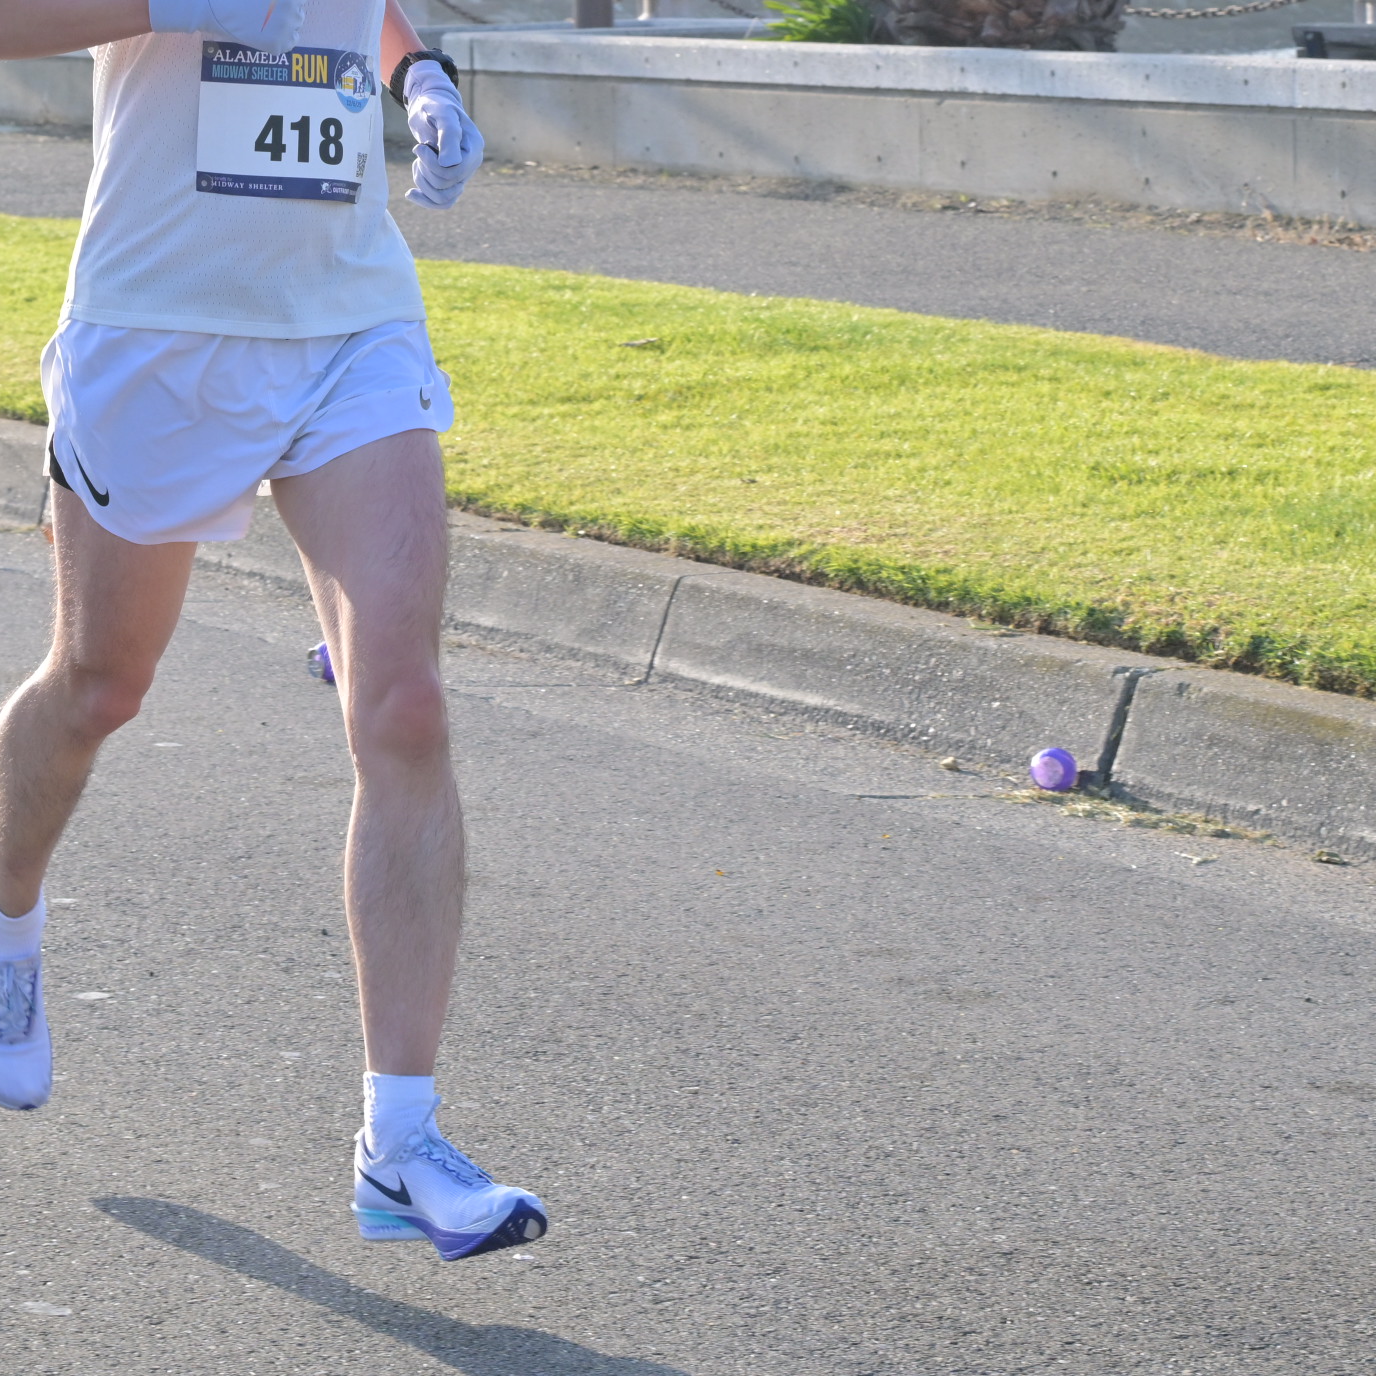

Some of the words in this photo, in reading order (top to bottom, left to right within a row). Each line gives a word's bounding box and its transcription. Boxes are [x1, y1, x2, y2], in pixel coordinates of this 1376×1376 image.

[213, 49, 289, 65] ALAMEDA
[212, 64, 250, 80] MIDWAY
[251, 66, 288, 82] SHELTER
[291, 53, 328, 84] RUN
[254, 115, 344, 165] 418
[248, 183, 284, 191] SHELTER
